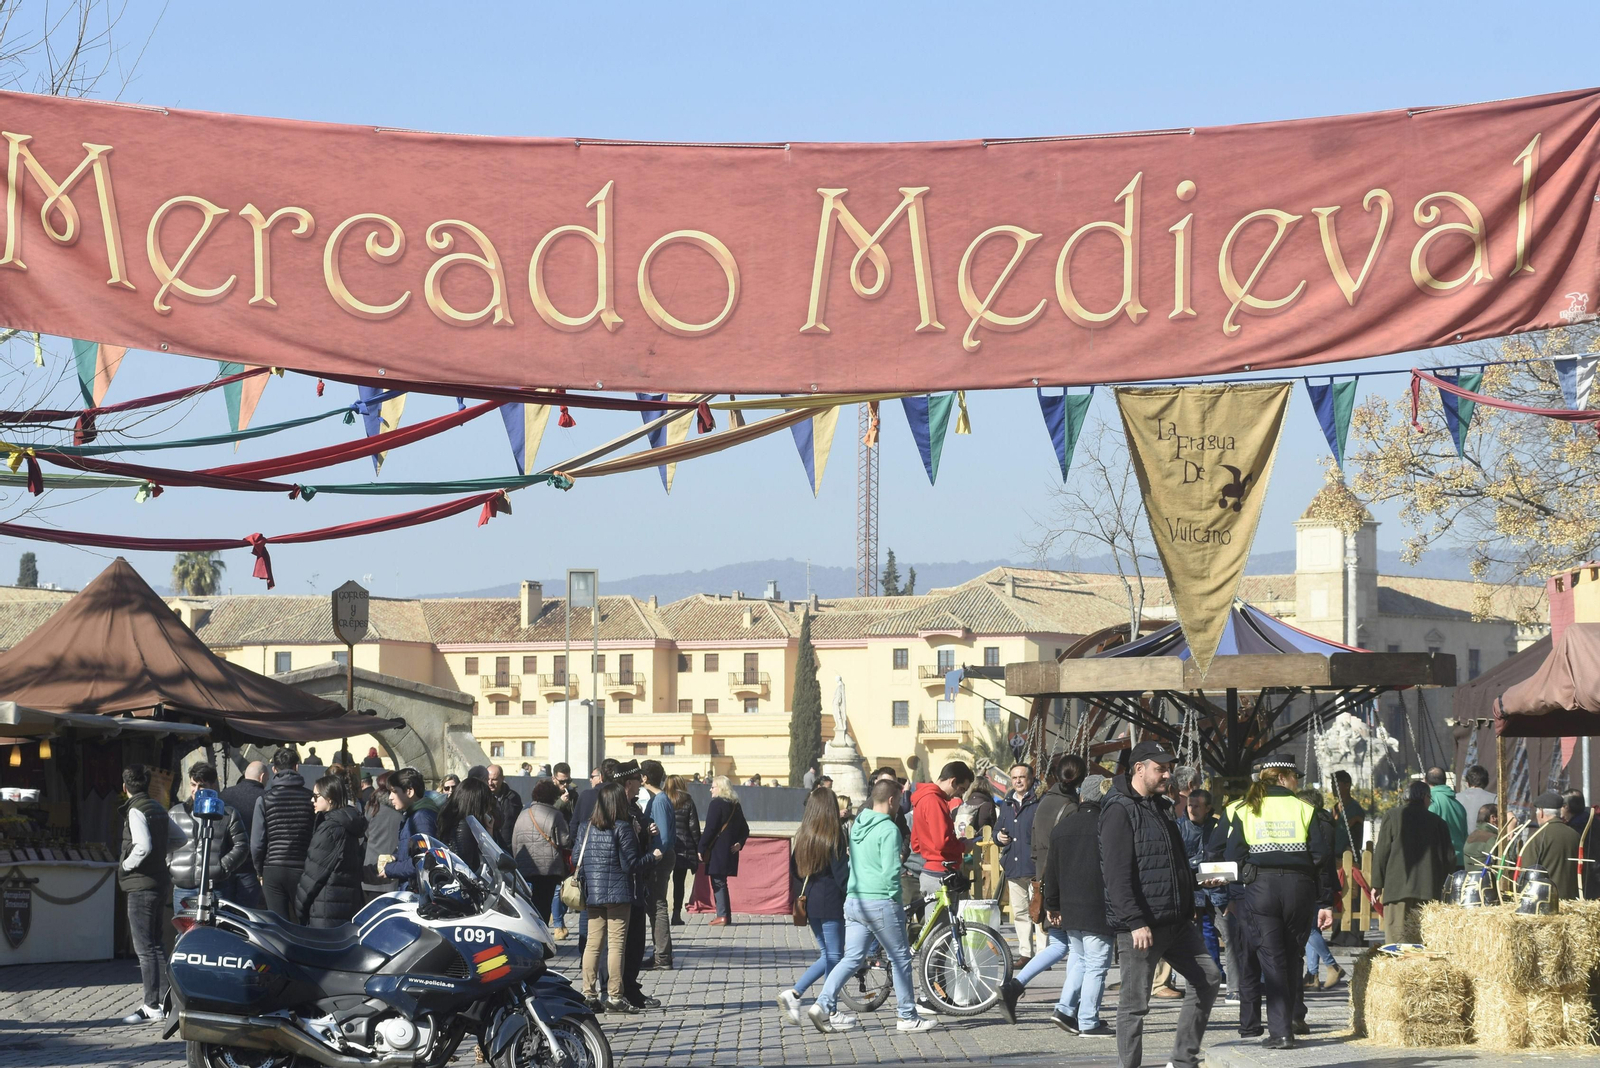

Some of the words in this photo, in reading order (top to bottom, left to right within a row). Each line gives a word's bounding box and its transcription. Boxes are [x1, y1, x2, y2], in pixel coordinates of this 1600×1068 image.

[0, 131, 741, 338] Mercado
[800, 133, 1541, 352] Medieval
[1157, 418, 1177, 441] La
[1174, 435, 1235, 459] Fragua
[1182, 460, 1206, 484] De
[1165, 517, 1231, 545] Vulcano
[464, 928, 495, 944] 091
[171, 952, 256, 971] POLICIA
[408, 977, 455, 988] www.policia.es
